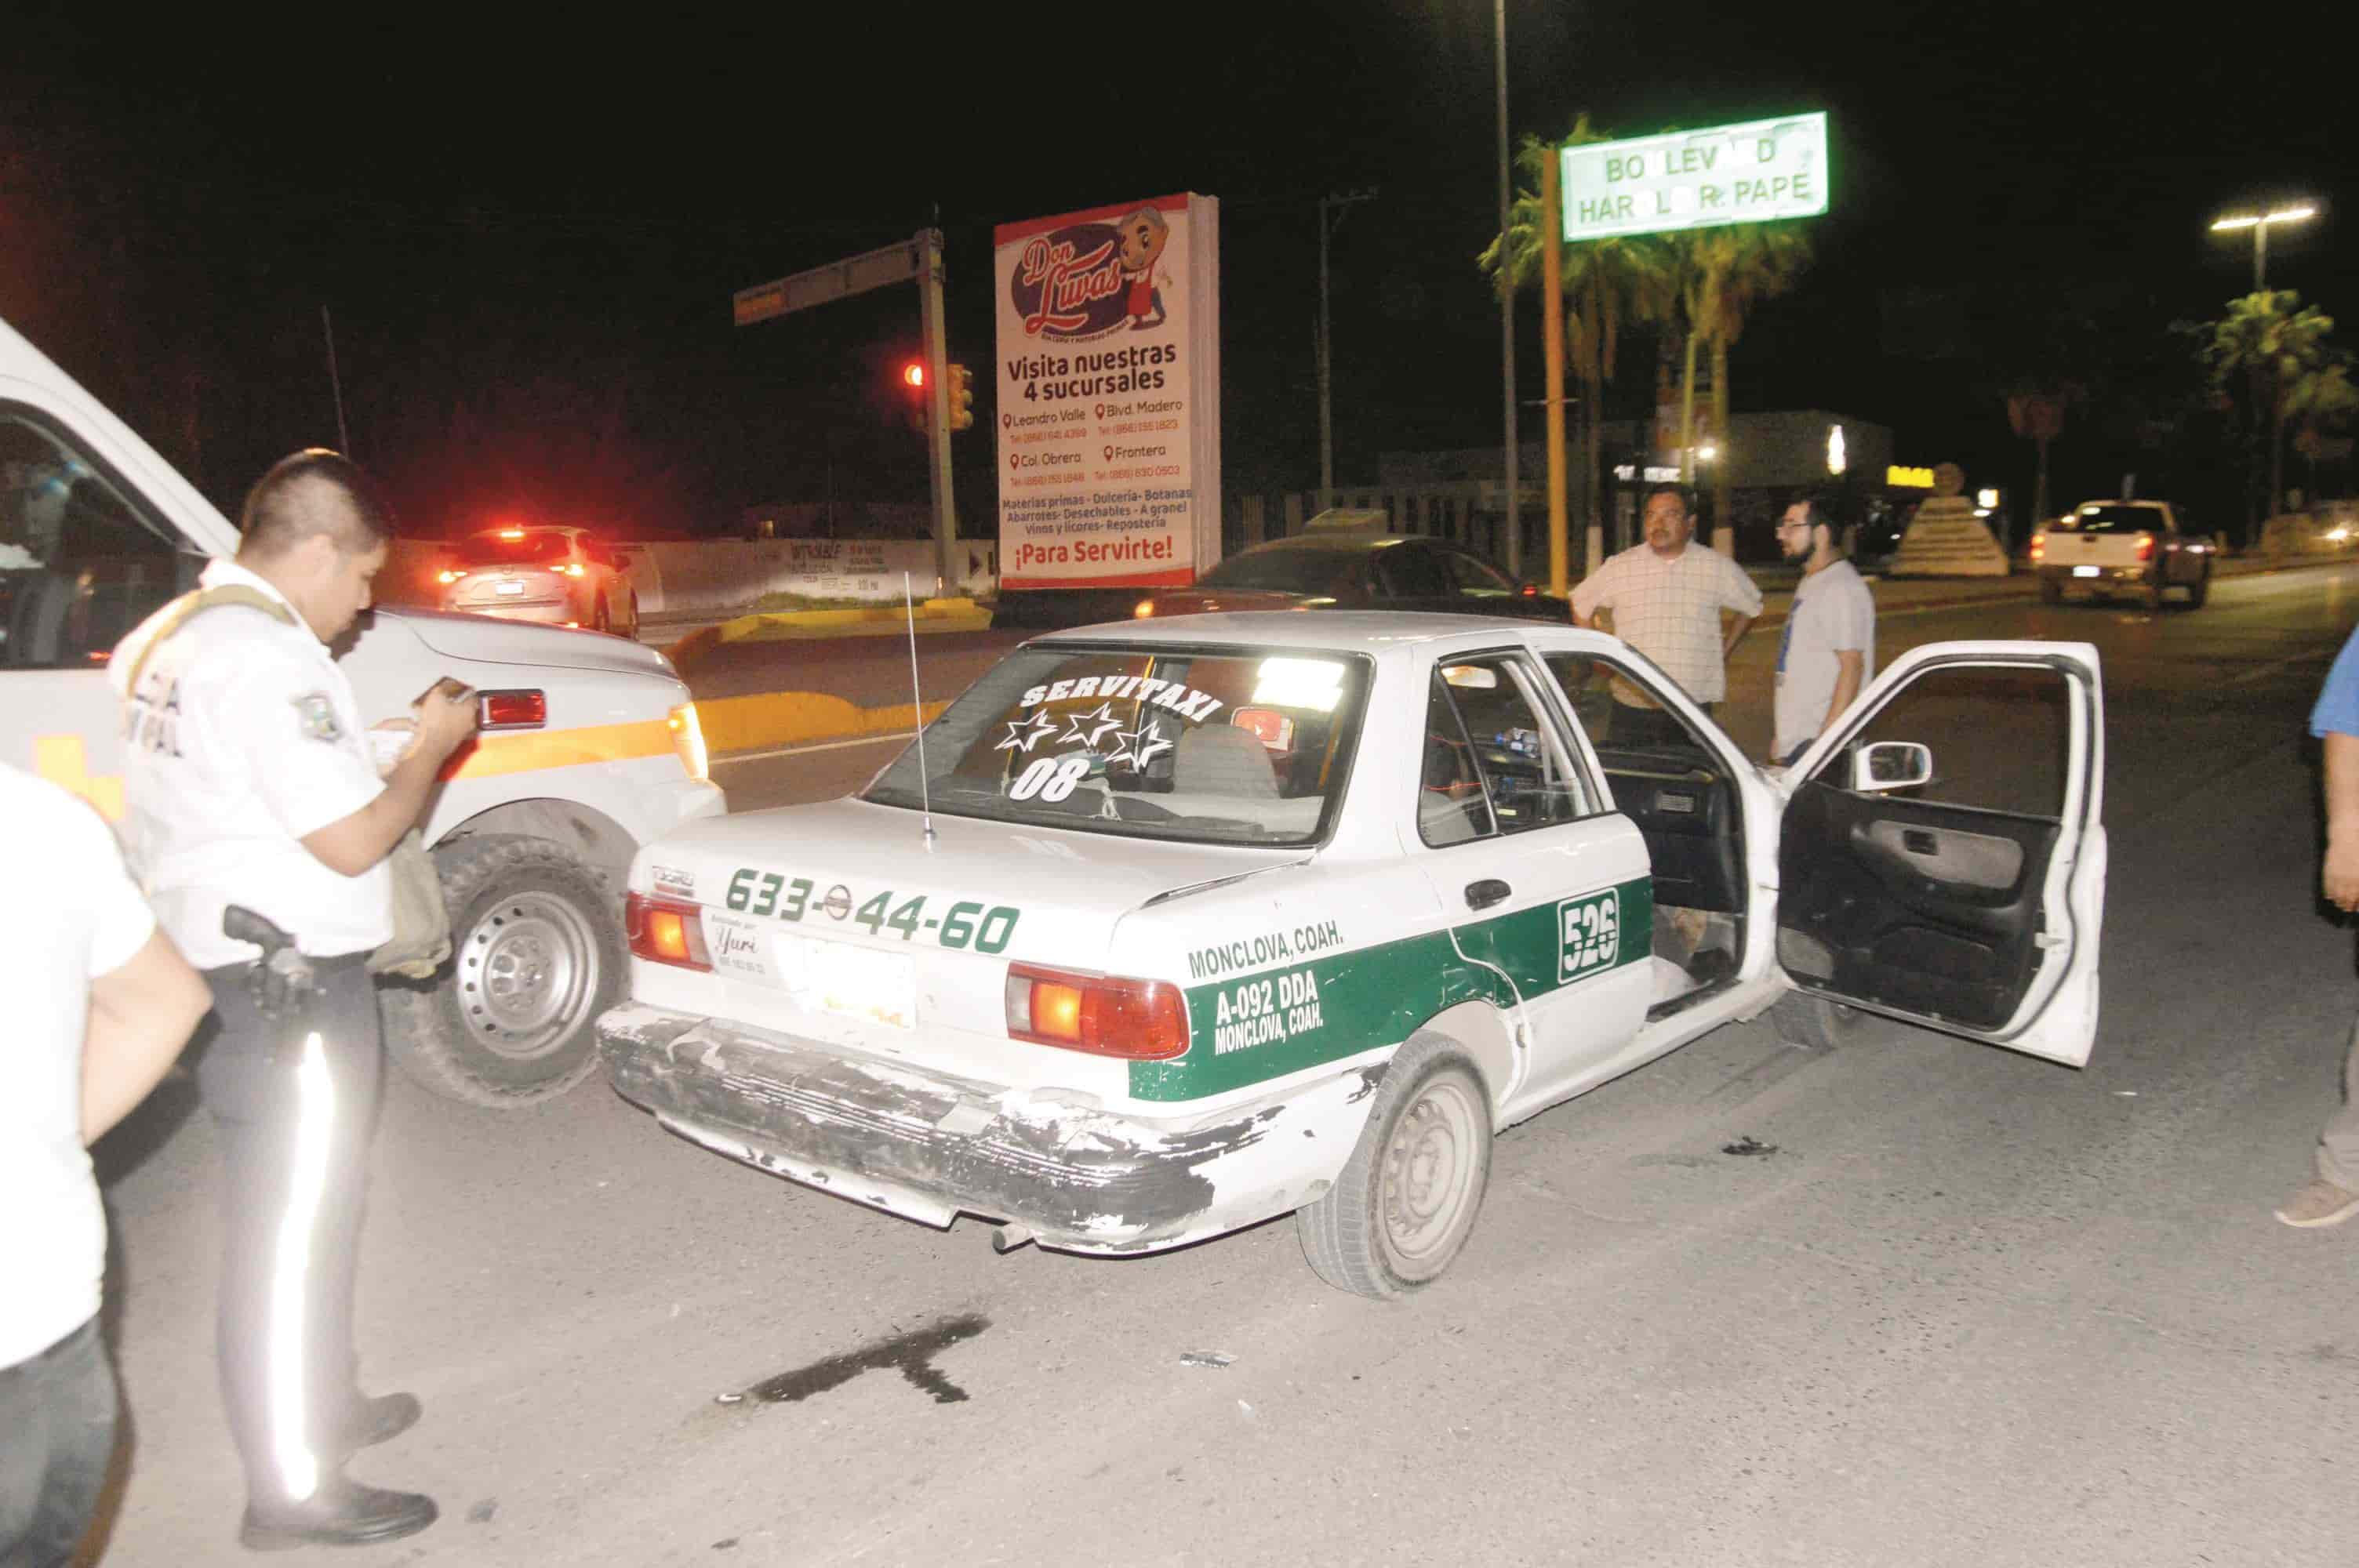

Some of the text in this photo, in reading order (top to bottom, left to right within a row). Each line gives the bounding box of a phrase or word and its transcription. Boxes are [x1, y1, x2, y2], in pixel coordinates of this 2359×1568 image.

[1605, 138, 1776, 183] BOLEVD
[1579, 191, 1689, 223] HARL
[1735, 173, 1810, 204] PAPE
[1023, 237, 1074, 286] Don
[1008, 343, 1176, 381] Visita nuestras
[1023, 368, 1165, 401] 4 sucursales
[1012, 408, 1086, 427] Leandro Valle
[1137, 399, 1183, 415] Madero
[1041, 452, 1081, 466] Obrera
[1115, 445, 1166, 459] Frontera
[1003, 495, 1046, 510] Materias
[1049, 495, 1084, 510] primas
[1145, 489, 1192, 501] Botanas
[1064, 507, 1130, 519] Desechables
[1150, 503, 1186, 517] granel
[1026, 524, 1053, 535] Vinos
[1056, 525, 1063, 535] y
[1107, 517, 1166, 531] Repostería
[1016, 535, 1172, 571] ¡Para Servirte!
[1020, 676, 1224, 722] SERVITAXI
[1009, 758, 1091, 803] 08
[1188, 920, 1343, 979] MONCLOVA, COAH.
[1565, 897, 1616, 971] 526
[1216, 969, 1318, 1025] A-092 DDA
[1215, 1004, 1323, 1054] MONCLOVA, COAH.
